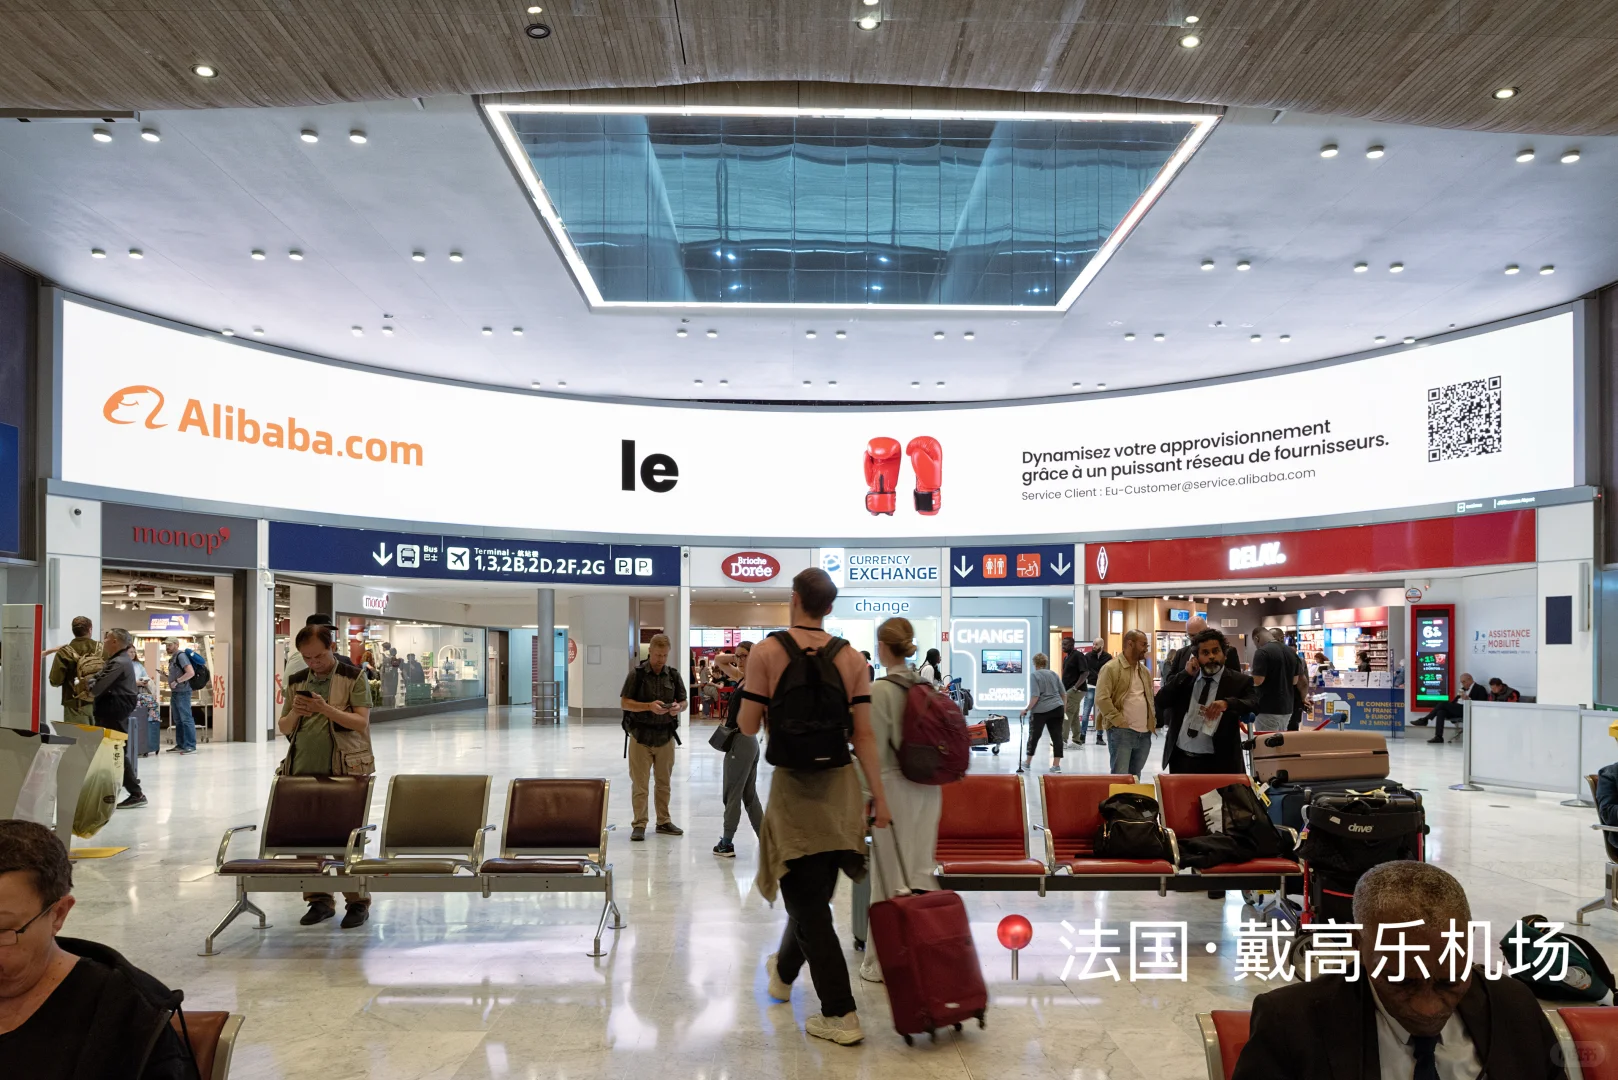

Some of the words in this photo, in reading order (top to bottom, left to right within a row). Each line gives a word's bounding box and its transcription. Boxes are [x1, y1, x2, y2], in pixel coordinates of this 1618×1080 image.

[177, 397, 424, 467] Alibaba.com
[1022, 446, 1111, 468] Dynamisez
[1114, 443, 1157, 458] votre
[1160, 419, 1332, 456] approvisionnement
[621, 438, 680, 494] le
[1022, 467, 1069, 486] grâce
[1072, 464, 1083, 480] à
[1086, 466, 1107, 478] un
[1111, 457, 1183, 481] puissant
[1186, 453, 1245, 470] réseau
[1248, 449, 1271, 464] de
[1274, 434, 1390, 461] fournisseurs.
[1021, 490, 1062, 501] Service
[1064, 487, 1097, 499] Client
[1105, 468, 1317, 497] Eu-Customer@service.alibaba.com
[423, 545, 438, 553] Bus
[474, 547, 510, 556] Terminal
[423, 553, 438, 562] 巴士
[737, 556, 767, 565] Brioche
[849, 555, 911, 565] CURRENCY
[730, 562, 773, 577] Dorée
[849, 567, 938, 580] EXCHANGE
[855, 599, 910, 615] change
[957, 629, 1025, 644] CHANGE
[1488, 629, 1531, 638] ASSISTANCE
[1488, 637, 1520, 648] MOBILITÉ
[1347, 823, 1373, 833] drive
